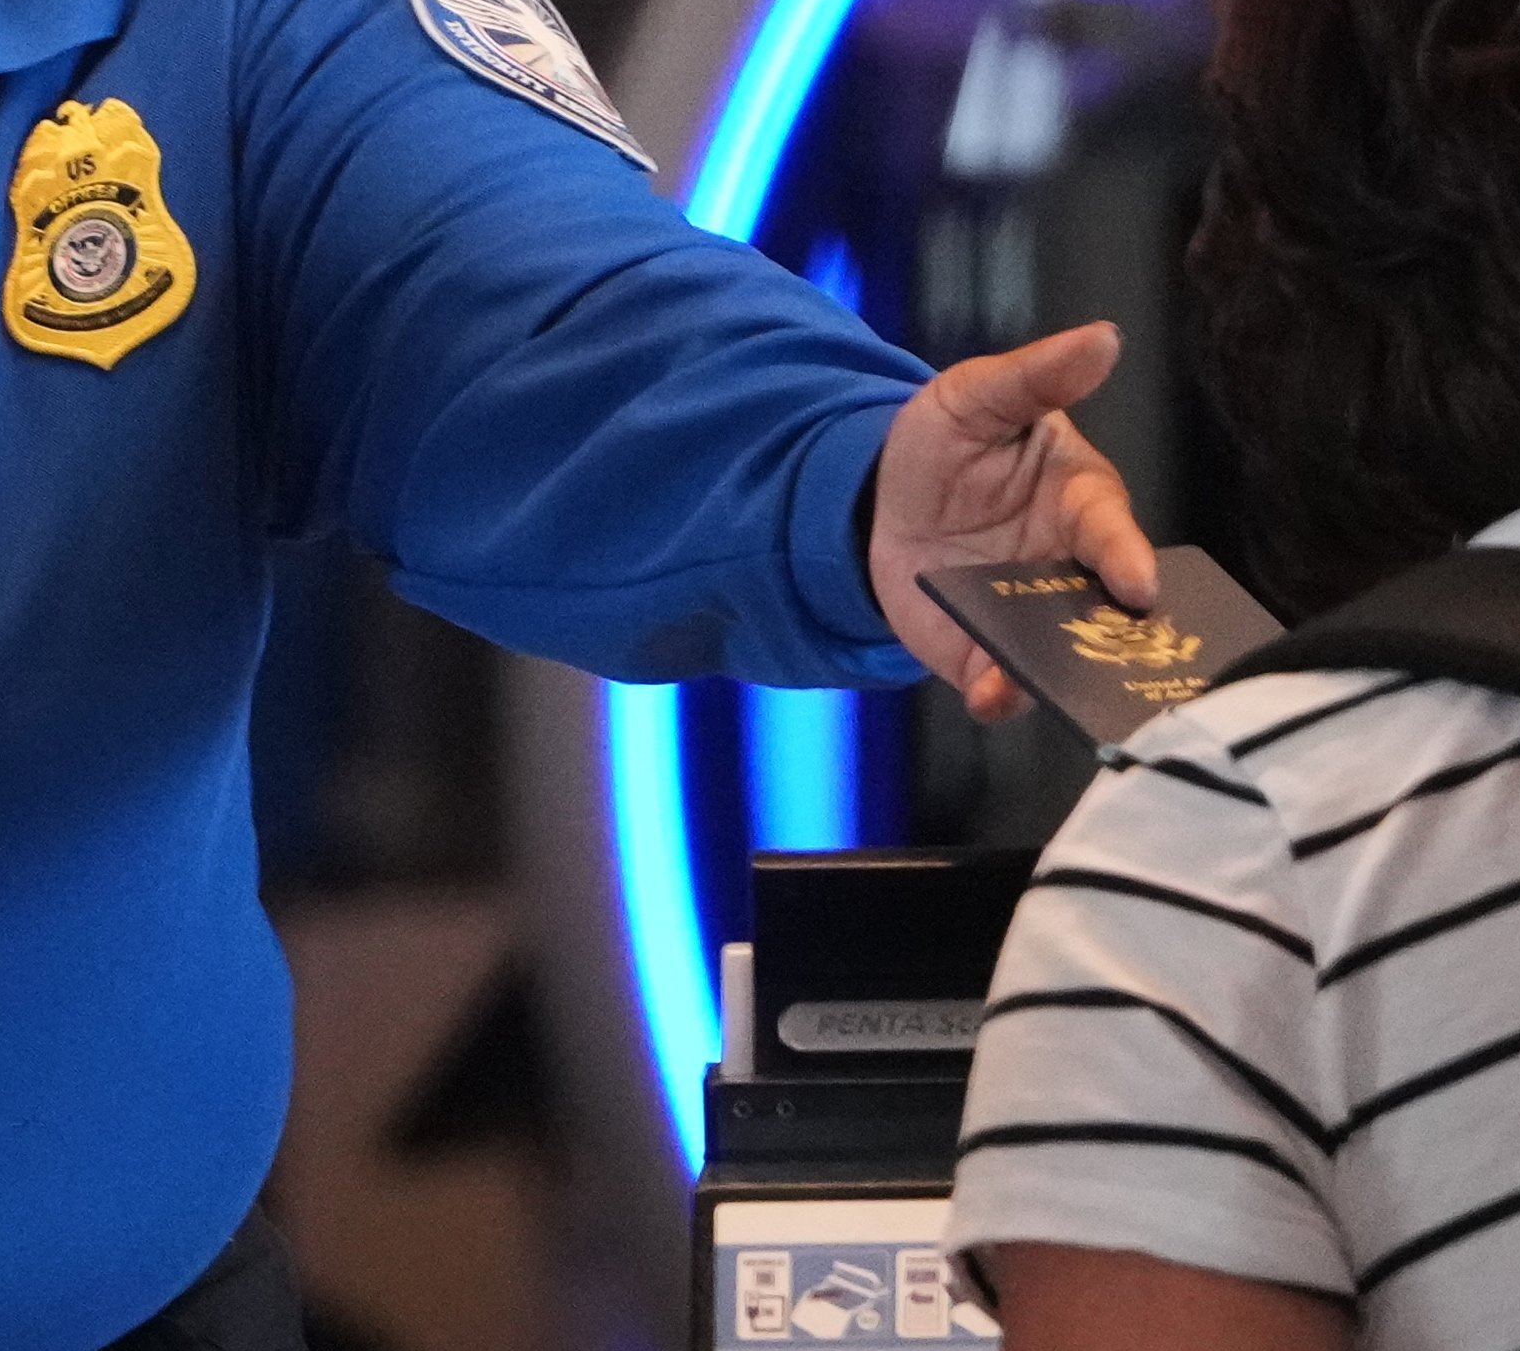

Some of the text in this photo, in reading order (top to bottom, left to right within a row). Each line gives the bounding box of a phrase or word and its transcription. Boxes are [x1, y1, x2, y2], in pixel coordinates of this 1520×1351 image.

[65, 153, 97, 181] US
[990, 576, 1089, 597] PASSP
[816, 1013, 928, 1036] PENTA
